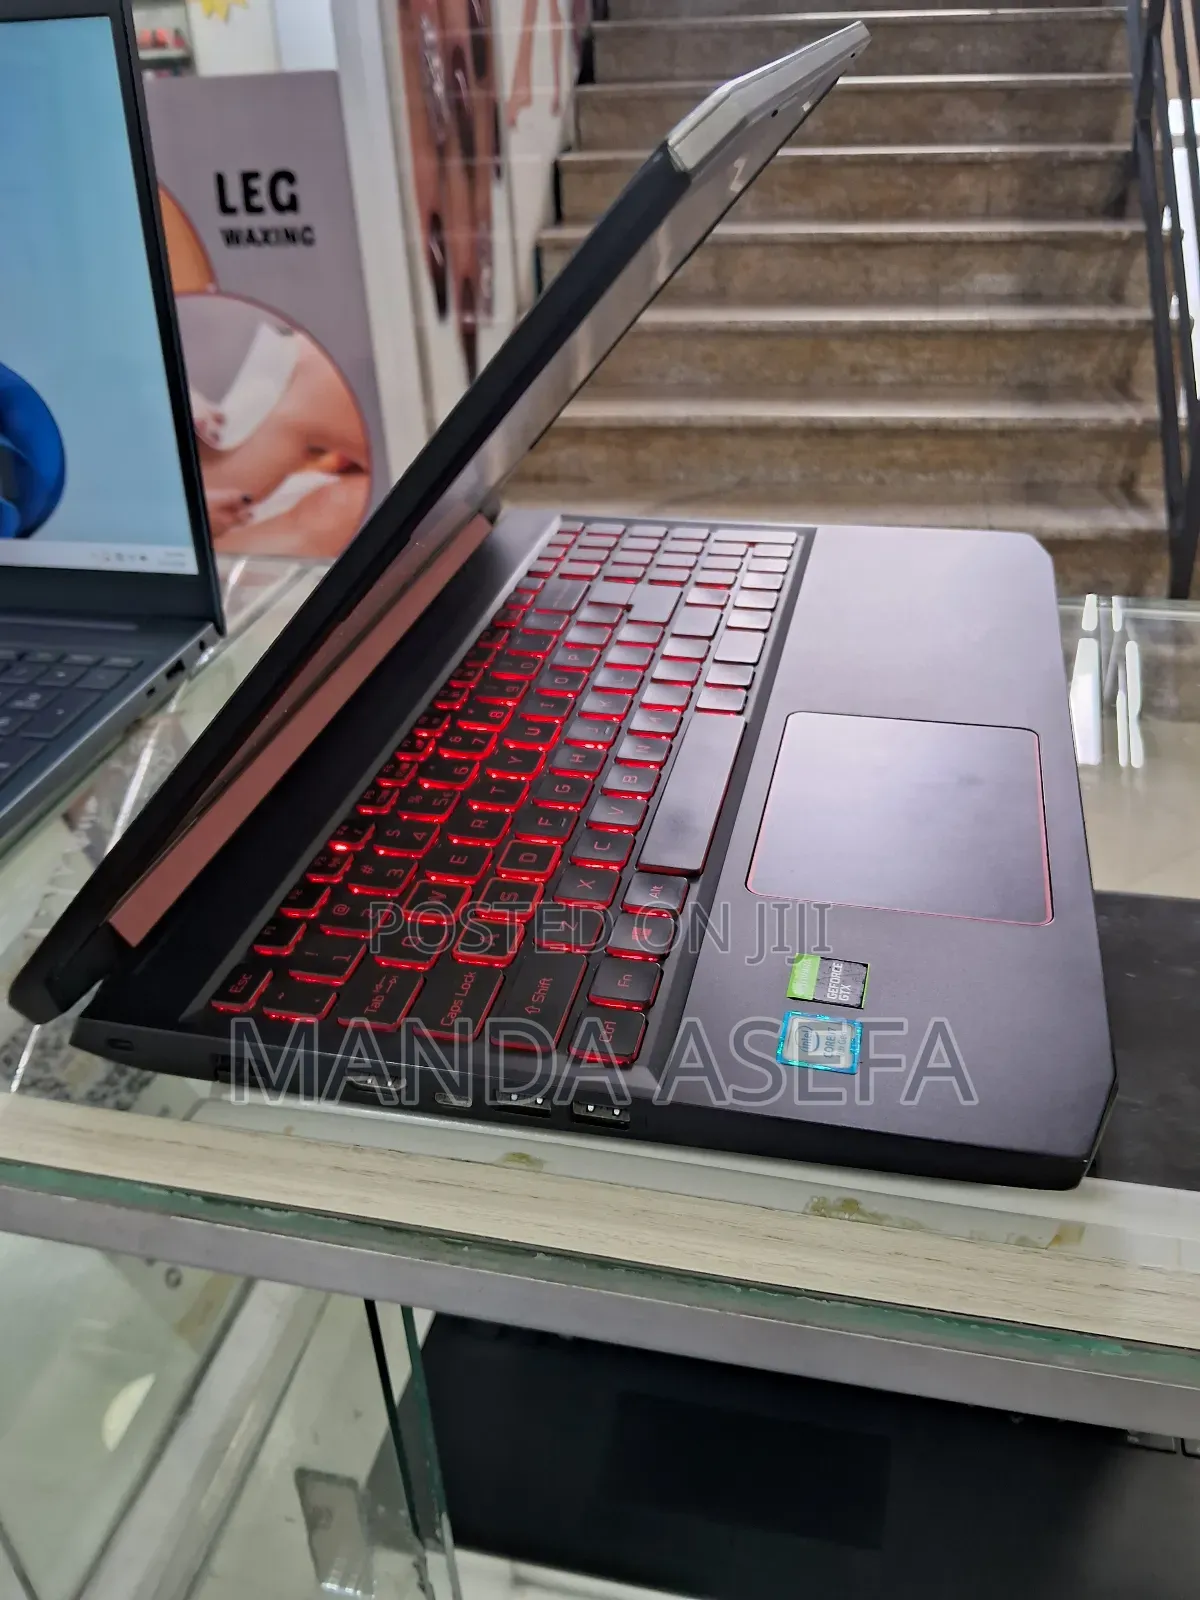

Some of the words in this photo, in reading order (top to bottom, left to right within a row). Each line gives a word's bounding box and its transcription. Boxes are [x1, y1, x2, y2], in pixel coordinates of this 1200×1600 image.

[215, 169, 298, 214] LEG
[220, 225, 315, 248] WAXING
[525, 726, 541, 737] U
[570, 753, 586, 764] H
[622, 774, 638, 785] B
[490, 785, 506, 795] T
[608, 805, 624, 816] V
[471, 818, 488, 830] R
[538, 815, 553, 827] F
[593, 840, 611, 851] C
[450, 853, 468, 866] E
[518, 852, 538, 864] D
[386, 867, 405, 878] 3
[579, 878, 596, 890] X
[499, 890, 519, 903] S
[648, 884, 665, 899] Alt
[228, 973, 253, 995] Esc
[617, 973, 634, 988] Fn
[827, 962, 844, 1000] GEFORCE
[531, 977, 554, 1003] Shift
[838, 984, 852, 1001] GTX
[364, 994, 385, 1014] Tab
[440, 997, 465, 1028] Caps
[456, 971, 478, 998] Lock
[599, 1020, 617, 1044] Ctrl
[823, 1034, 837, 1059] CORE
